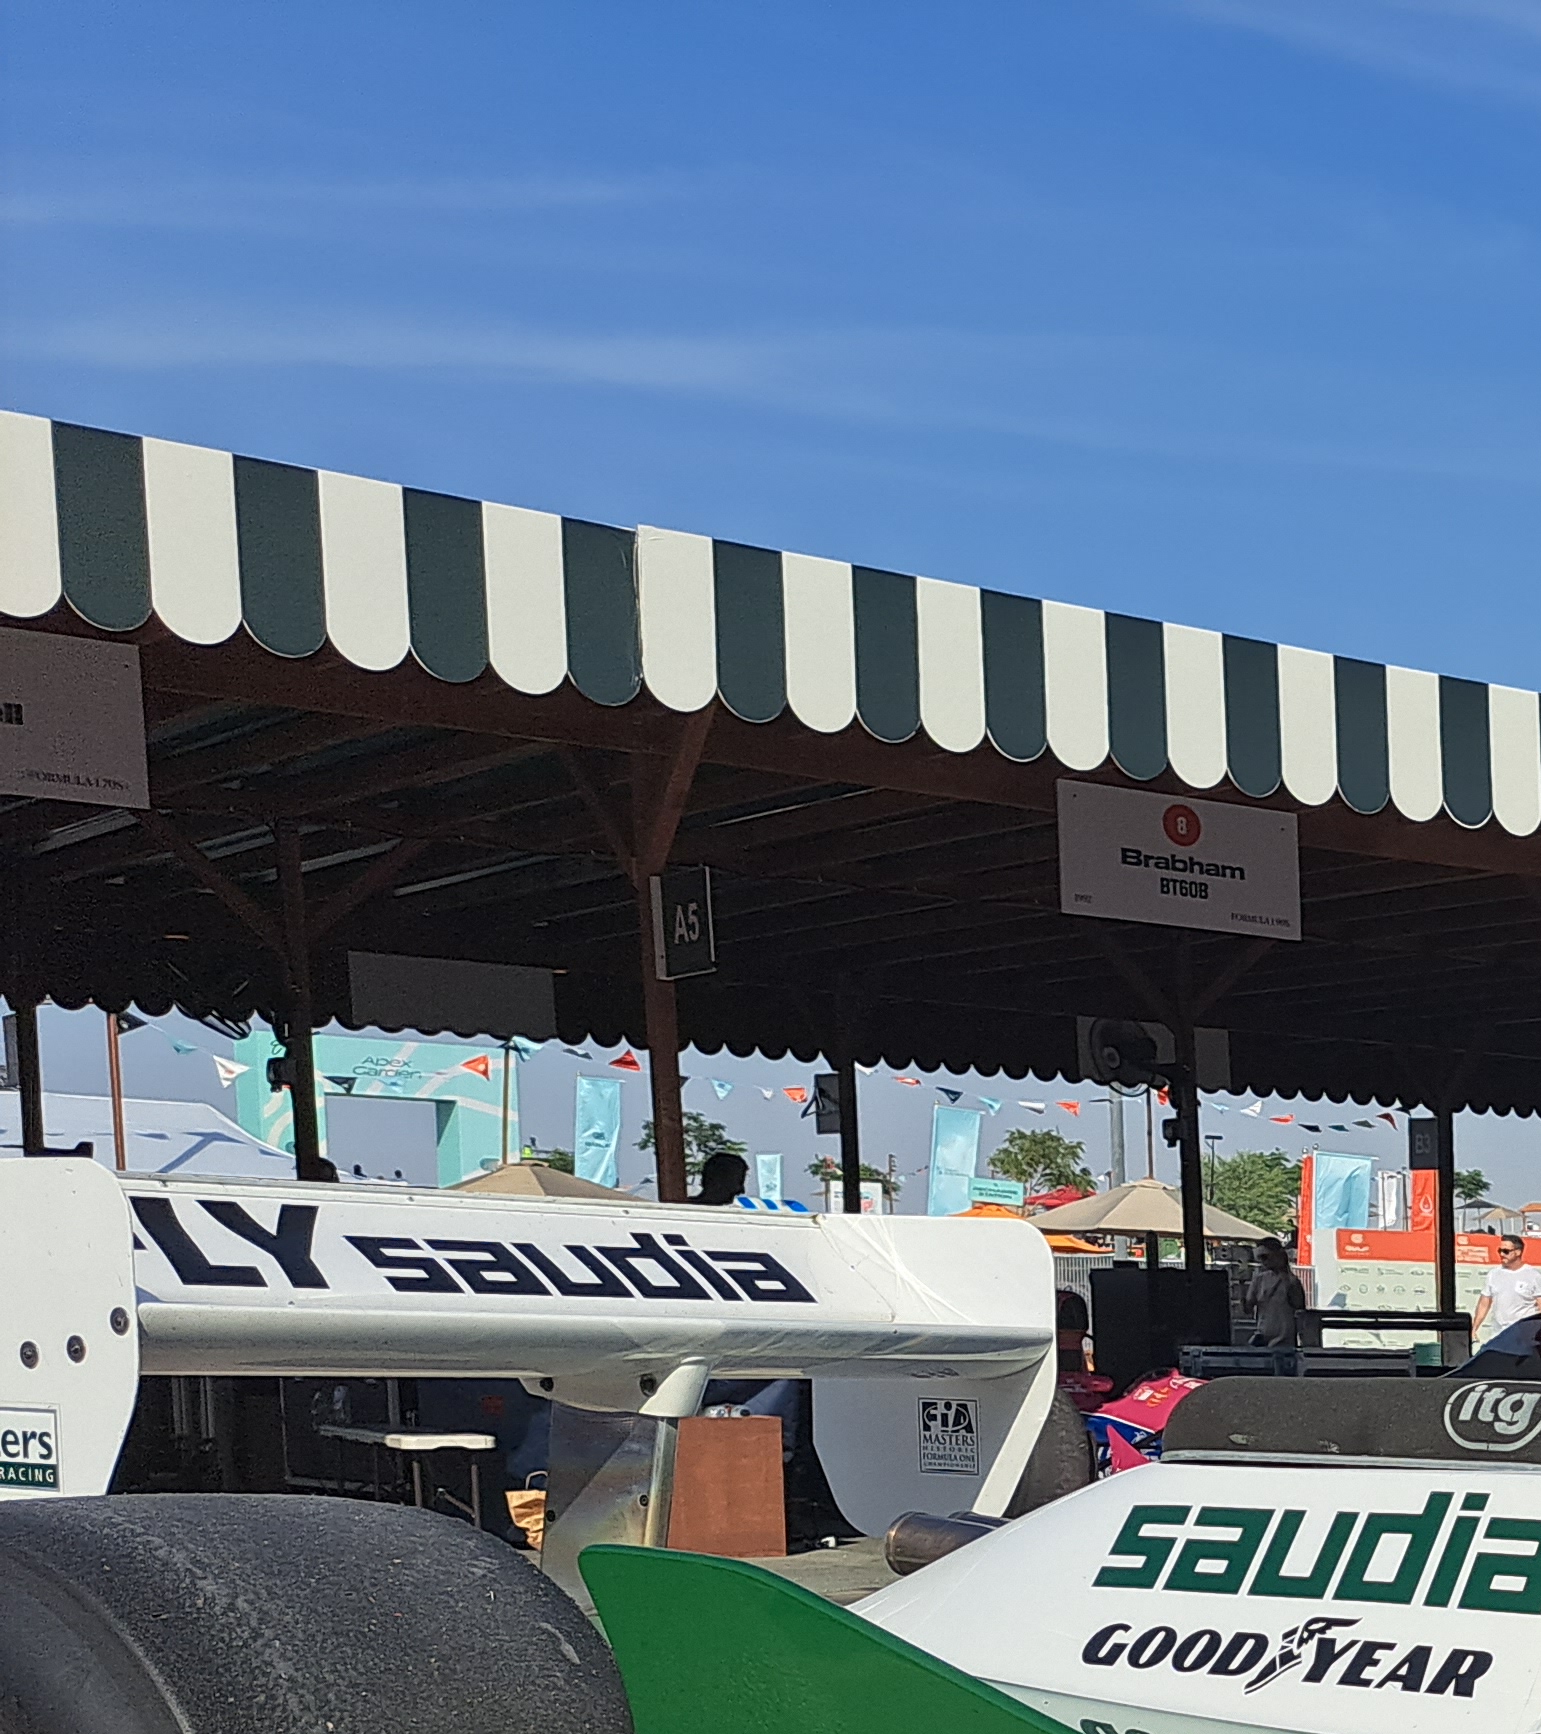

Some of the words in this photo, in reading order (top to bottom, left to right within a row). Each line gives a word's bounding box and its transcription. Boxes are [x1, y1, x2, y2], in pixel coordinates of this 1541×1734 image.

[1120, 847, 1246, 880] Brabham
[1160, 877, 1209, 900] BT60B
[674, 902, 700, 945] A5
[361, 1056, 413, 1069] Apex
[129, 1197, 331, 1289] LY
[344, 1231, 819, 1303] saudia
[922, 1433, 976, 1446] MASTERS
[922, 1453, 958, 1462] FORMULA
